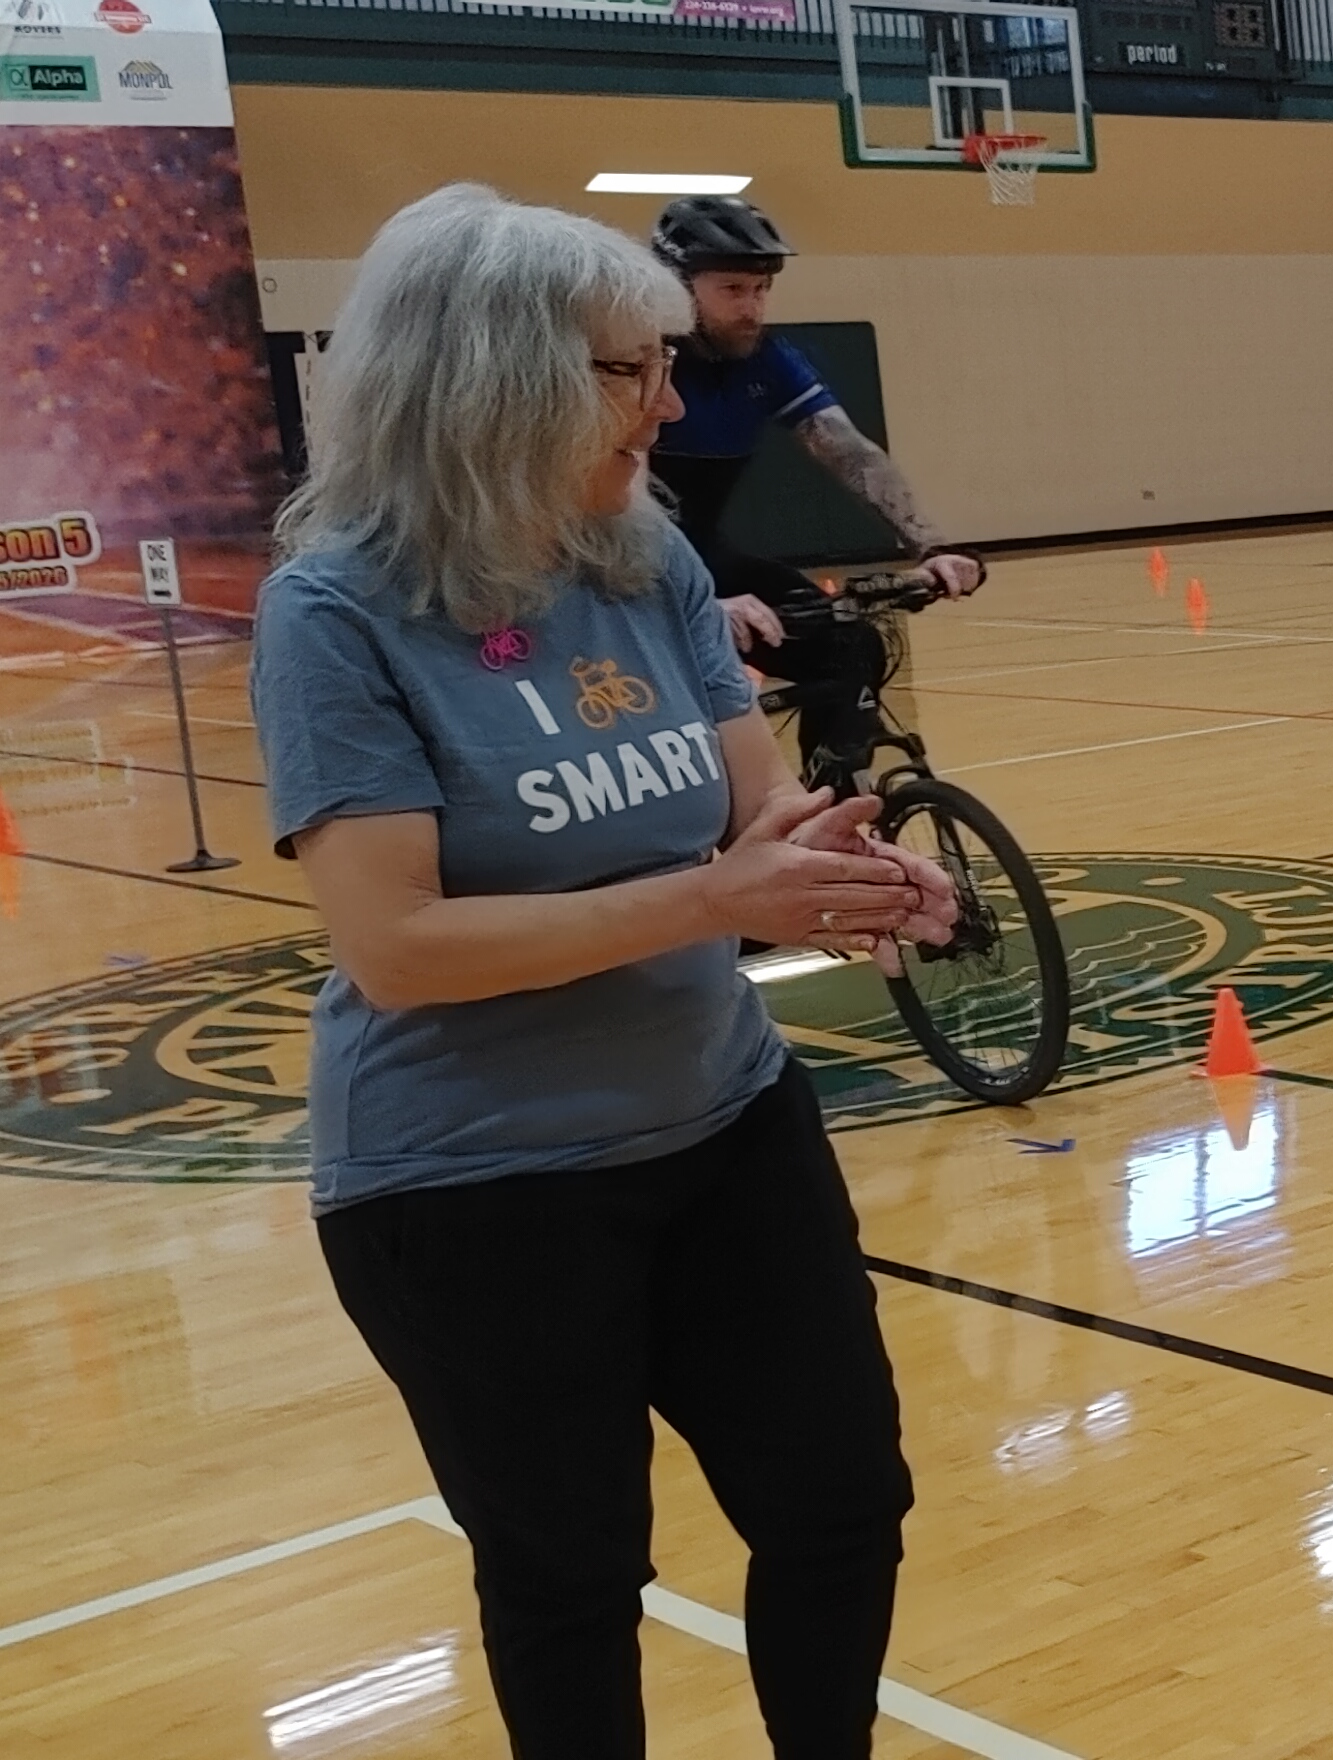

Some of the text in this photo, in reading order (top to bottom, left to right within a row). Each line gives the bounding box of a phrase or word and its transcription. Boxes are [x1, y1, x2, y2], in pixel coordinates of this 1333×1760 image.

[1127, 44, 1178, 65] period
[33, 68, 84, 87] Alpha
[60, 517, 92, 557] 5
[514, 679, 562, 736] I
[516, 720, 720, 833] SMART
